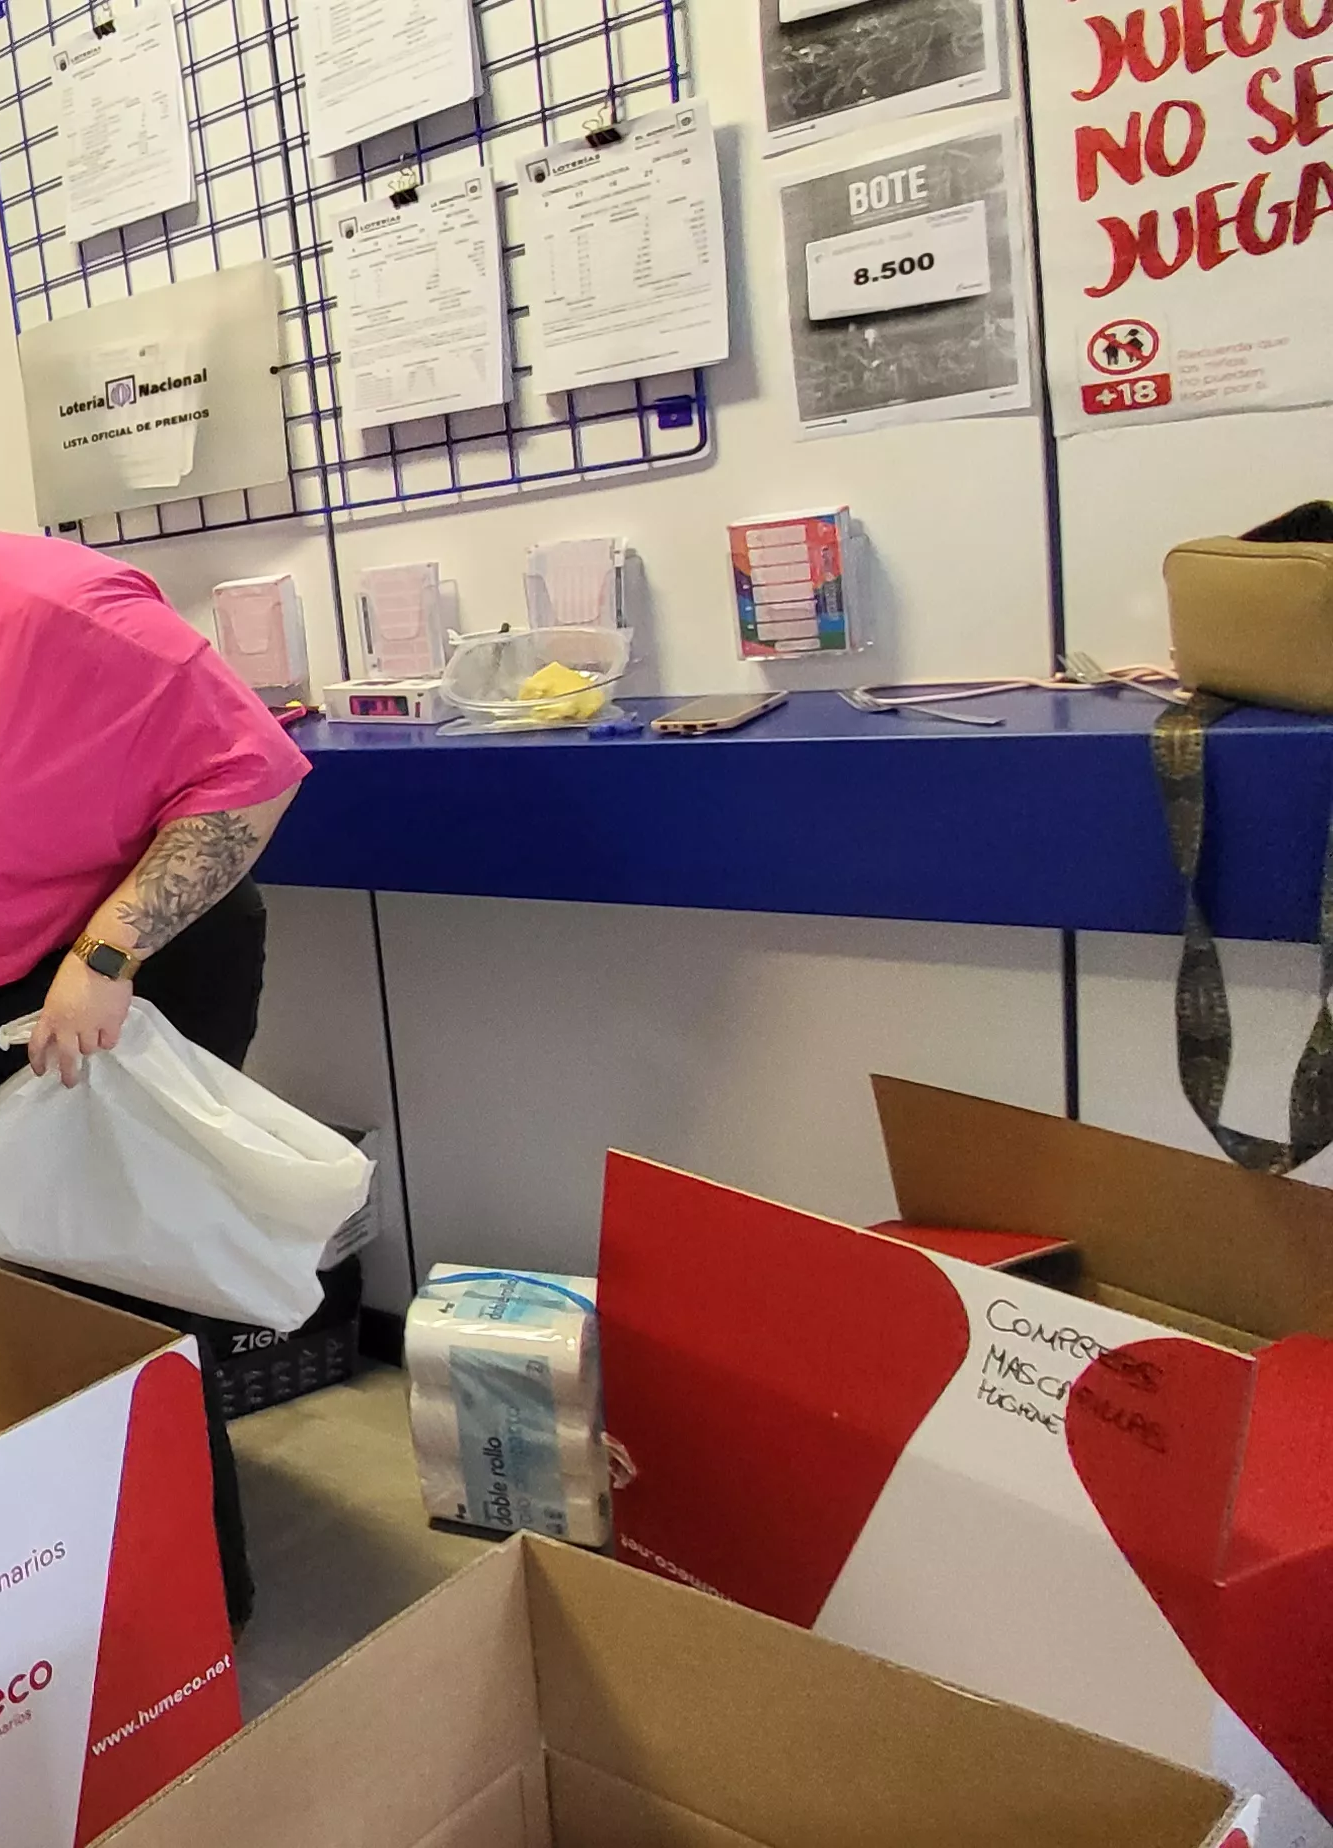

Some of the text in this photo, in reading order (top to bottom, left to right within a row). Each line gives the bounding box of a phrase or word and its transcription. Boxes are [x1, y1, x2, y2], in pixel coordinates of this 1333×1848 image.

[1074, 55, 1333, 202] NO SE
[848, 165, 929, 216] BOTE
[1083, 161, 1333, 298] JUEGA
[854, 252, 935, 285] 8.500
[138, 368, 207, 397] Nacional
[1095, 380, 1158, 406] +18
[63, 409, 210, 450] LISTA OFICIAL DE PREMIOS
[483, 1436, 513, 1527] doble rollo
[91, 1653, 231, 1756] www.humeco.net
